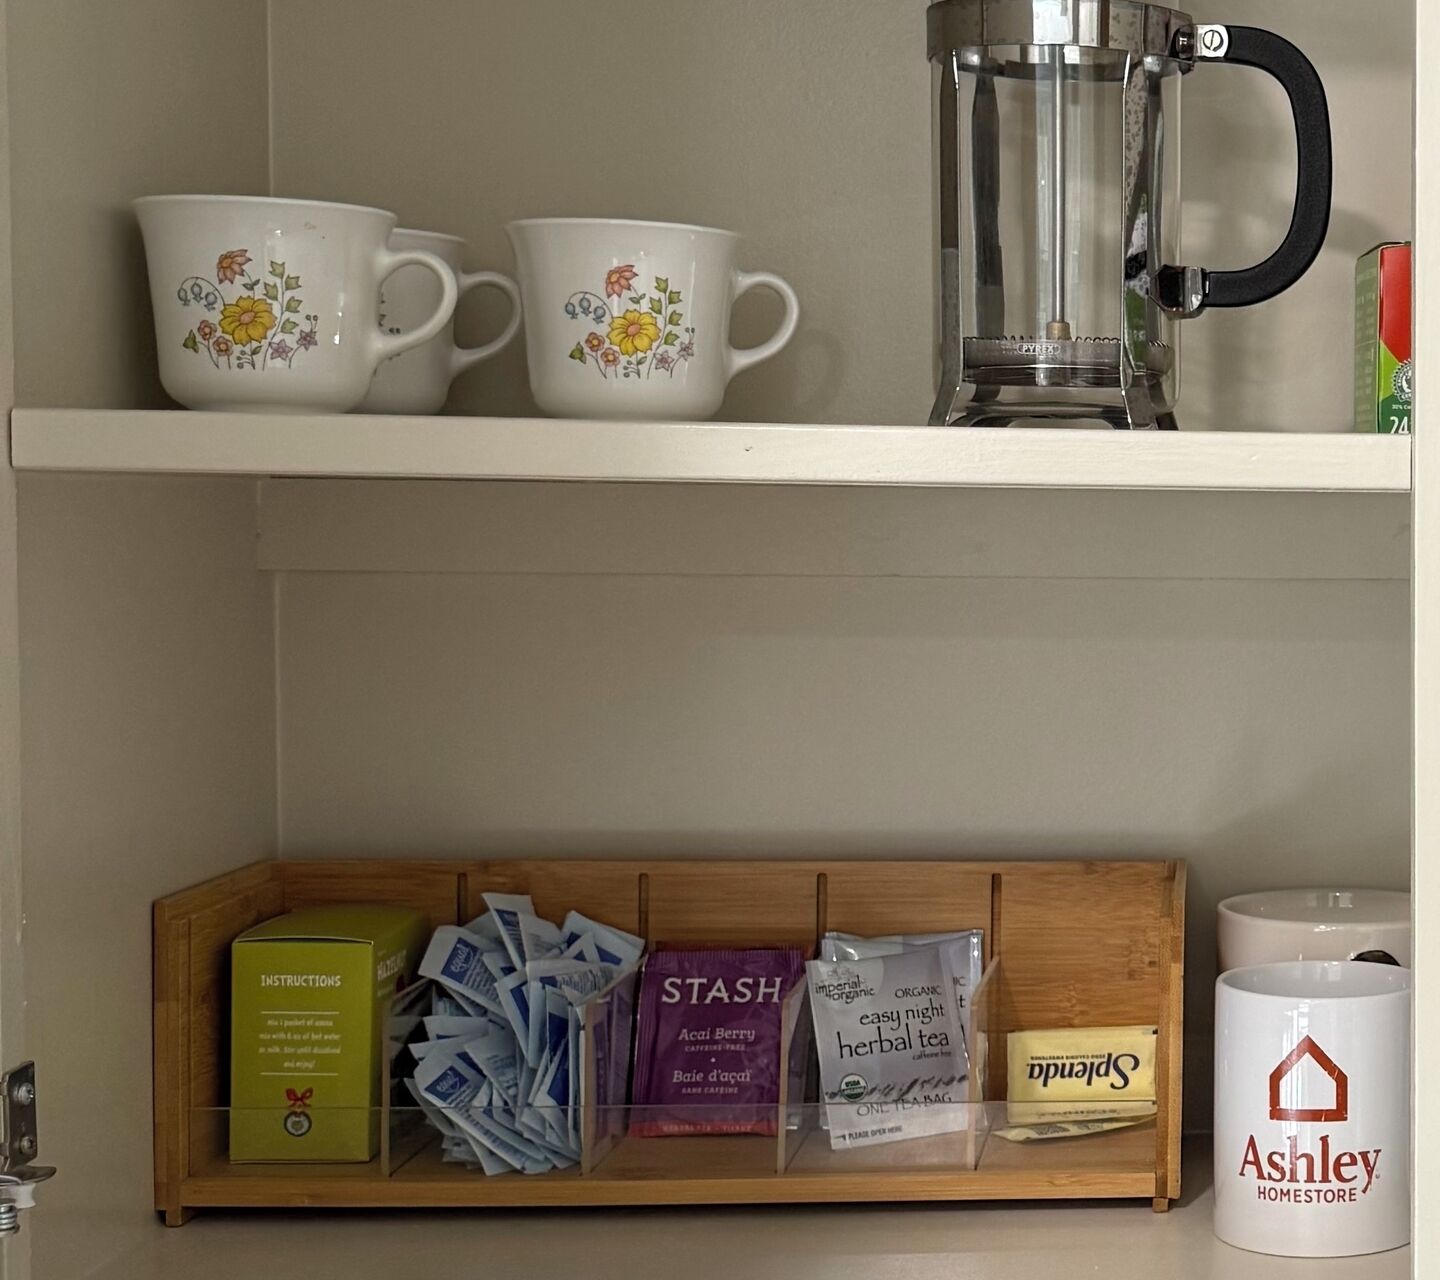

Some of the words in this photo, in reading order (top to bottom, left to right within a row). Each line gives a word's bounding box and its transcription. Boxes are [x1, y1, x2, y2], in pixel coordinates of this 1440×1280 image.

[1022, 345, 1055, 354] PYREX
[261, 974, 342, 987] INSTRUCTIONS
[815, 975, 861, 998] imperial
[661, 977, 783, 1005] STASH
[829, 986, 876, 1004] organic
[895, 985, 943, 999] ORGANIC
[859, 1007, 901, 1031] easy
[905, 997, 945, 1025] night
[714, 1027, 756, 1043] Berry
[837, 1022, 913, 1059] herbal
[919, 1029, 949, 1049] tea
[672, 1070, 704, 1083] Baie
[1028, 1053, 1140, 1090] Splenda
[857, 1102, 889, 1116] ONE
[894, 1097, 921, 1113] TEA
[924, 1091, 952, 1108] BAG
[848, 1129, 869, 1140] PLEASE
[870, 1127, 887, 1136] OPEN
[1239, 1134, 1382, 1194] Ashley
[1258, 1186, 1357, 1204] HOMESTORE
